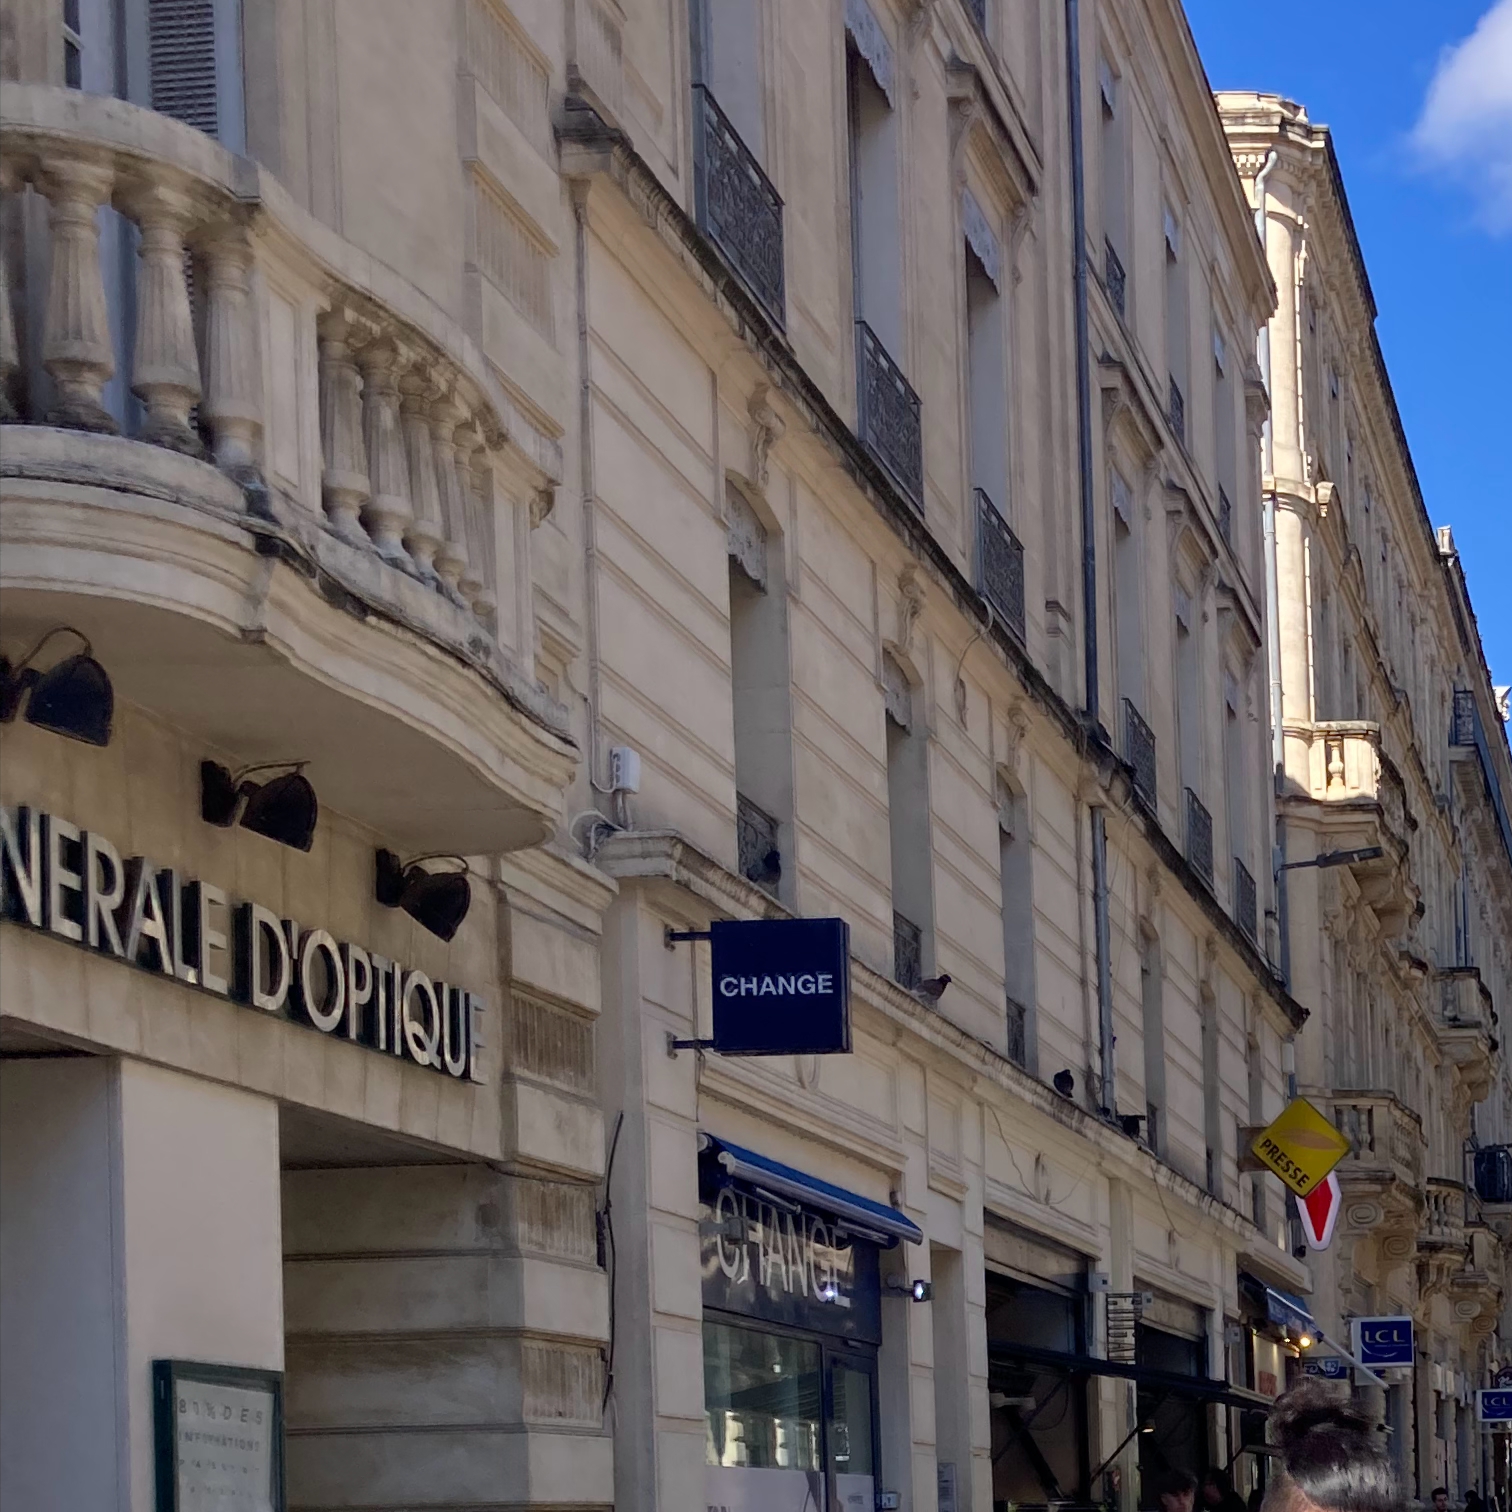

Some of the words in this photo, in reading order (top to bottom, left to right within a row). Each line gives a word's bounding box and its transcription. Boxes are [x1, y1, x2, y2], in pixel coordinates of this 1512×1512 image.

[719, 974, 833, 997] CHANGE
[1259, 1138, 1310, 1188] PRESSE
[1365, 1330, 1405, 1343] LCL
[1484, 1397, 1511, 1406] LCL
